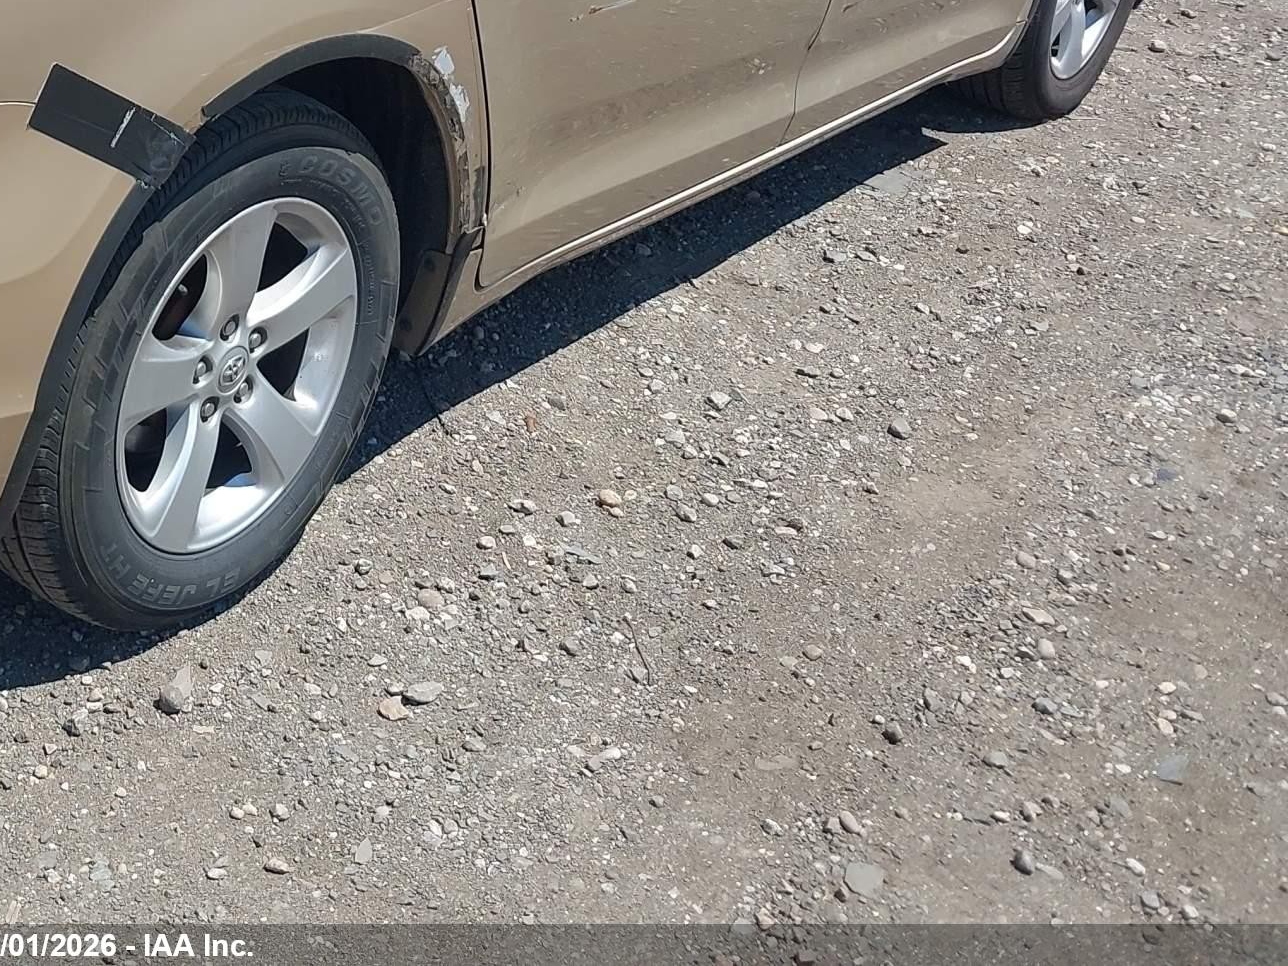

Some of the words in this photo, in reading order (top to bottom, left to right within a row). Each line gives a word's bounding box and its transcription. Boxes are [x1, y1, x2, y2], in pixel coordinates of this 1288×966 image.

[298, 155, 384, 226] COSMO
[100, 543, 131, 580] HT
[127, 573, 198, 605] JEFE
[206, 566, 241, 597] EL
